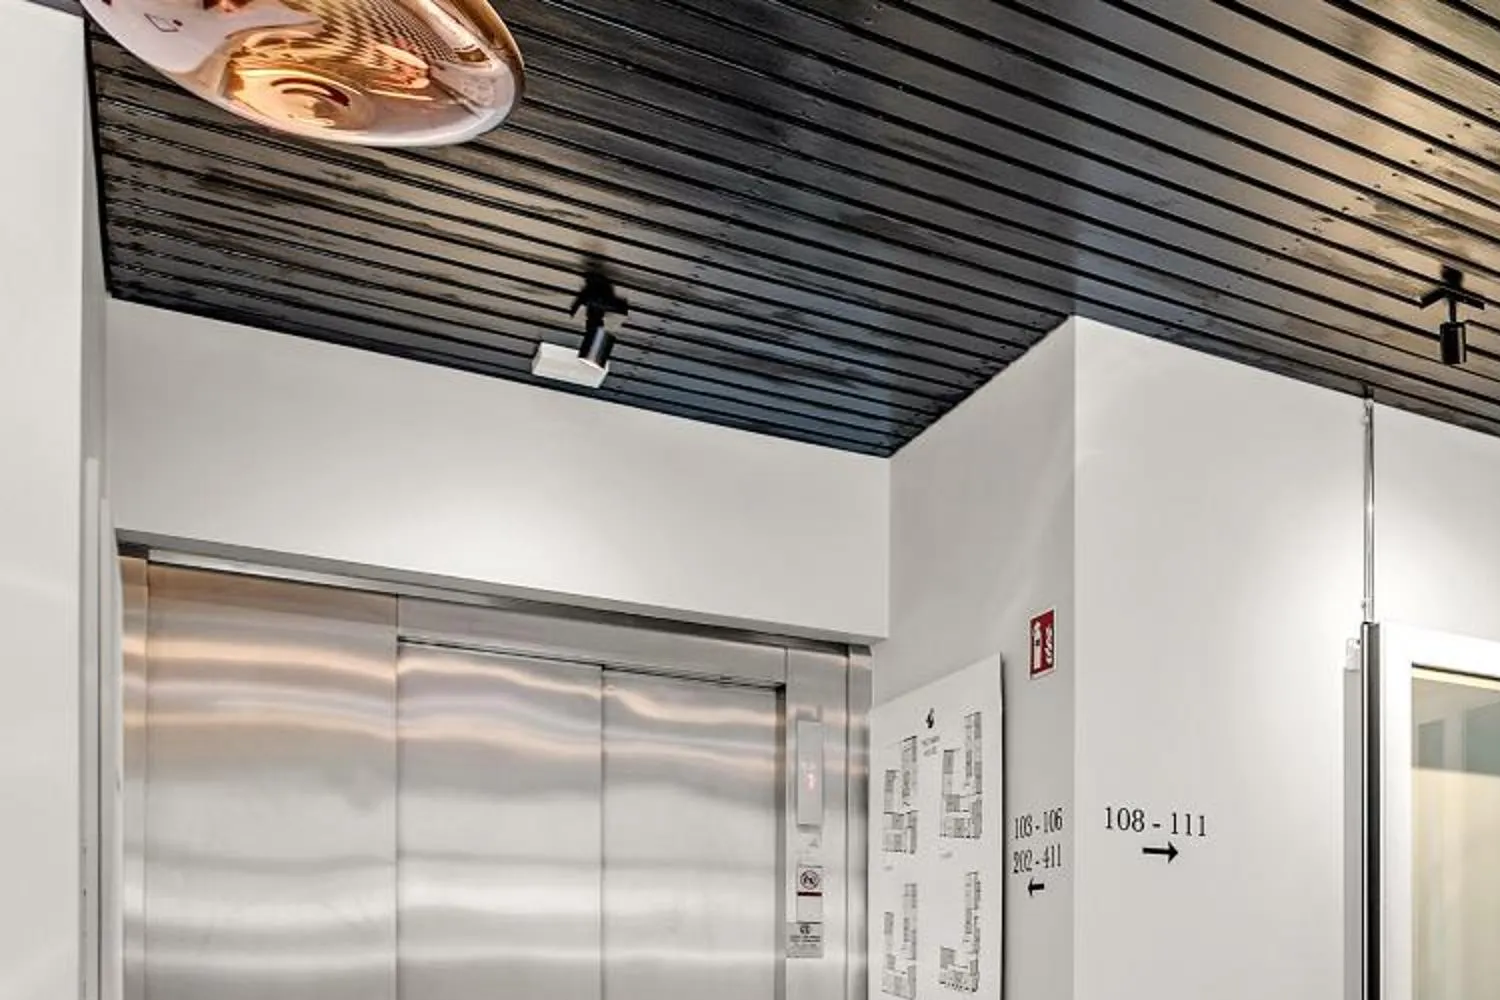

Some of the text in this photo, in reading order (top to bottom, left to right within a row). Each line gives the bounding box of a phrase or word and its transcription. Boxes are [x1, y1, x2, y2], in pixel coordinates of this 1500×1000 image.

[1043, 807, 1063, 833] 106
[1105, 806, 1145, 832] 108
[1171, 812, 1206, 837] 111
[1014, 849, 1033, 874] 202
[1042, 844, 1062, 869] 411
